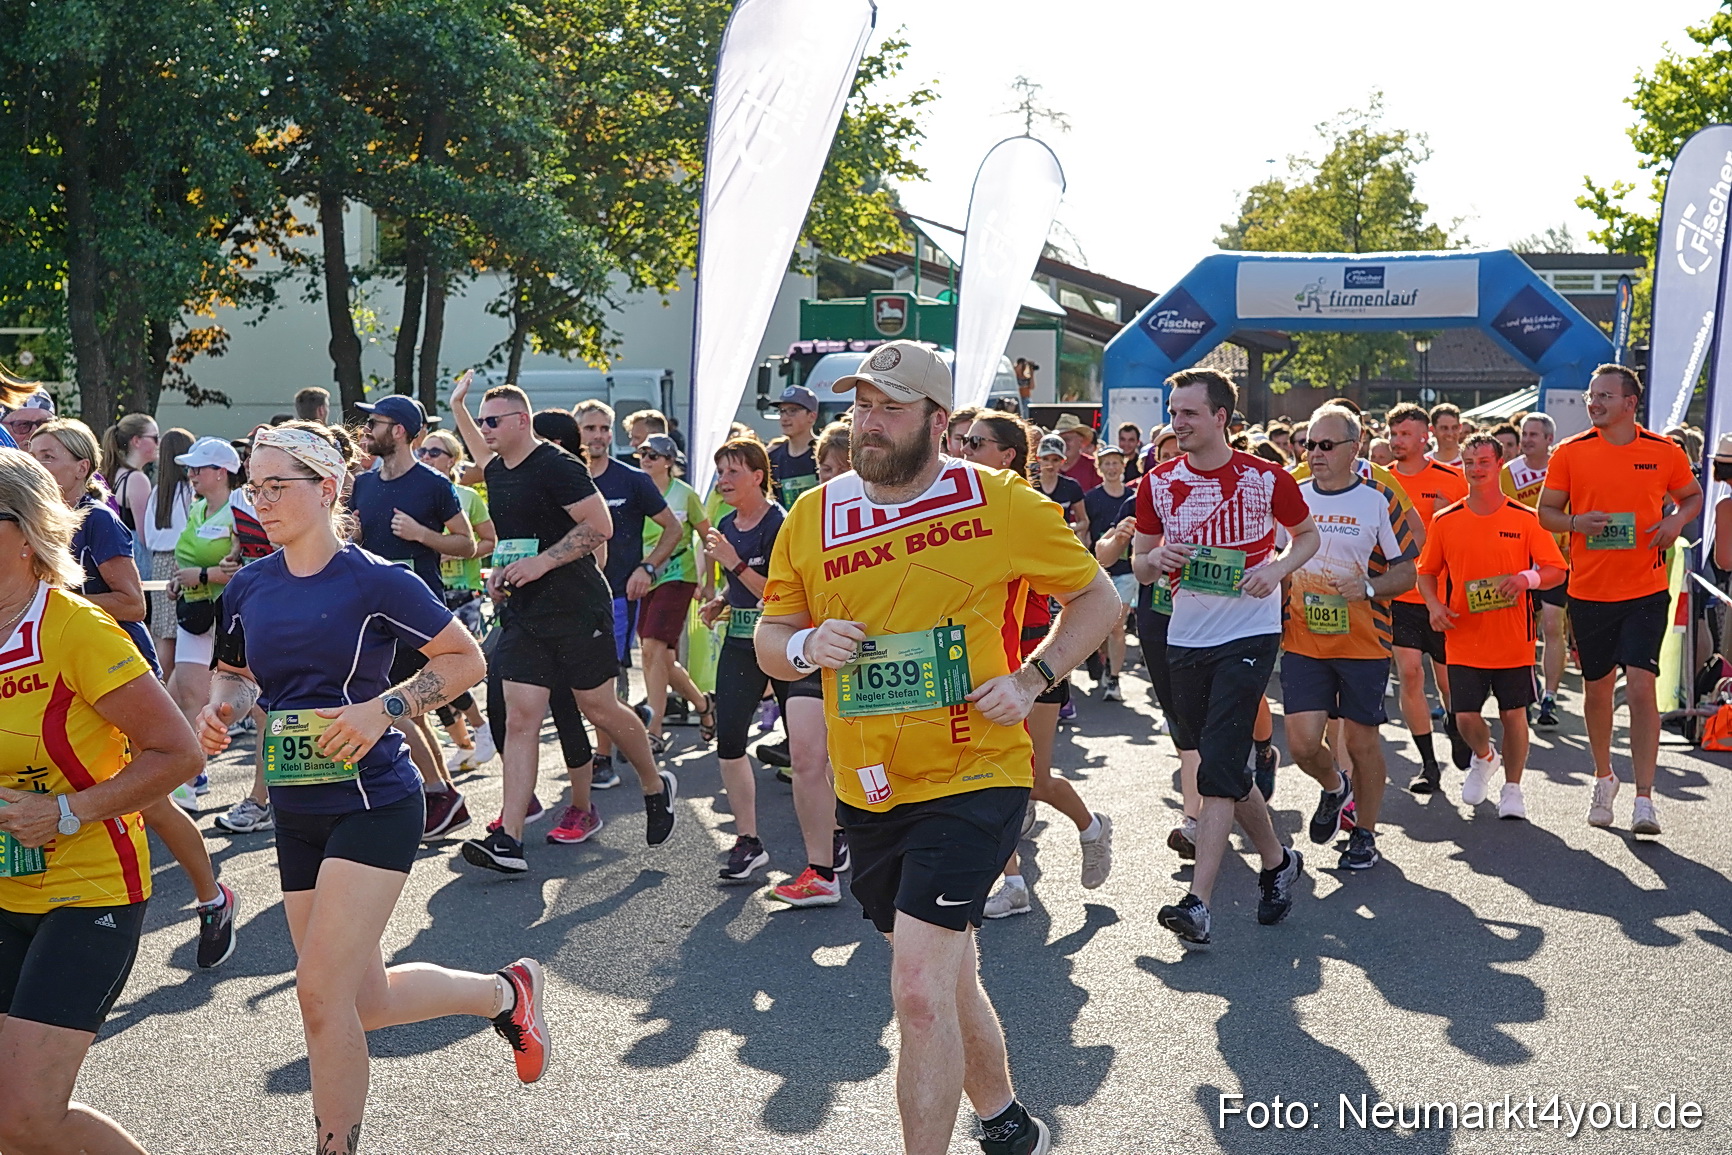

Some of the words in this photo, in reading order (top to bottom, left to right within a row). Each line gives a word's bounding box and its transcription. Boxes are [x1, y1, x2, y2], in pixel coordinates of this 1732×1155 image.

[1329, 289, 1419, 306] firmenlauf
[1157, 318, 1206, 329] Fischer
[1517, 486, 1541, 500] MAX
[1319, 525, 1360, 537] NAMICS
[1499, 531, 1521, 539] THULE
[1597, 525, 1628, 538] 394
[824, 541, 896, 582] MAX
[905, 517, 993, 555] BÖGL
[500, 553, 528, 567] 172
[1192, 560, 1233, 581] 1101
[732, 611, 759, 624] 1167
[1308, 606, 1339, 622] 1081
[859, 649, 888, 659] Firmenlauf
[852, 660, 920, 690] 1639
[922, 661, 936, 698] 2022
[0, 673, 49, 701] ÖGL
[842, 674, 851, 701] RUN
[855, 692, 885, 703] Negler
[888, 689, 919, 700] Stefan
[280, 762, 302, 772] Klebl
[304, 761, 335, 771] Bianca
[94, 920, 117, 929] adidas
